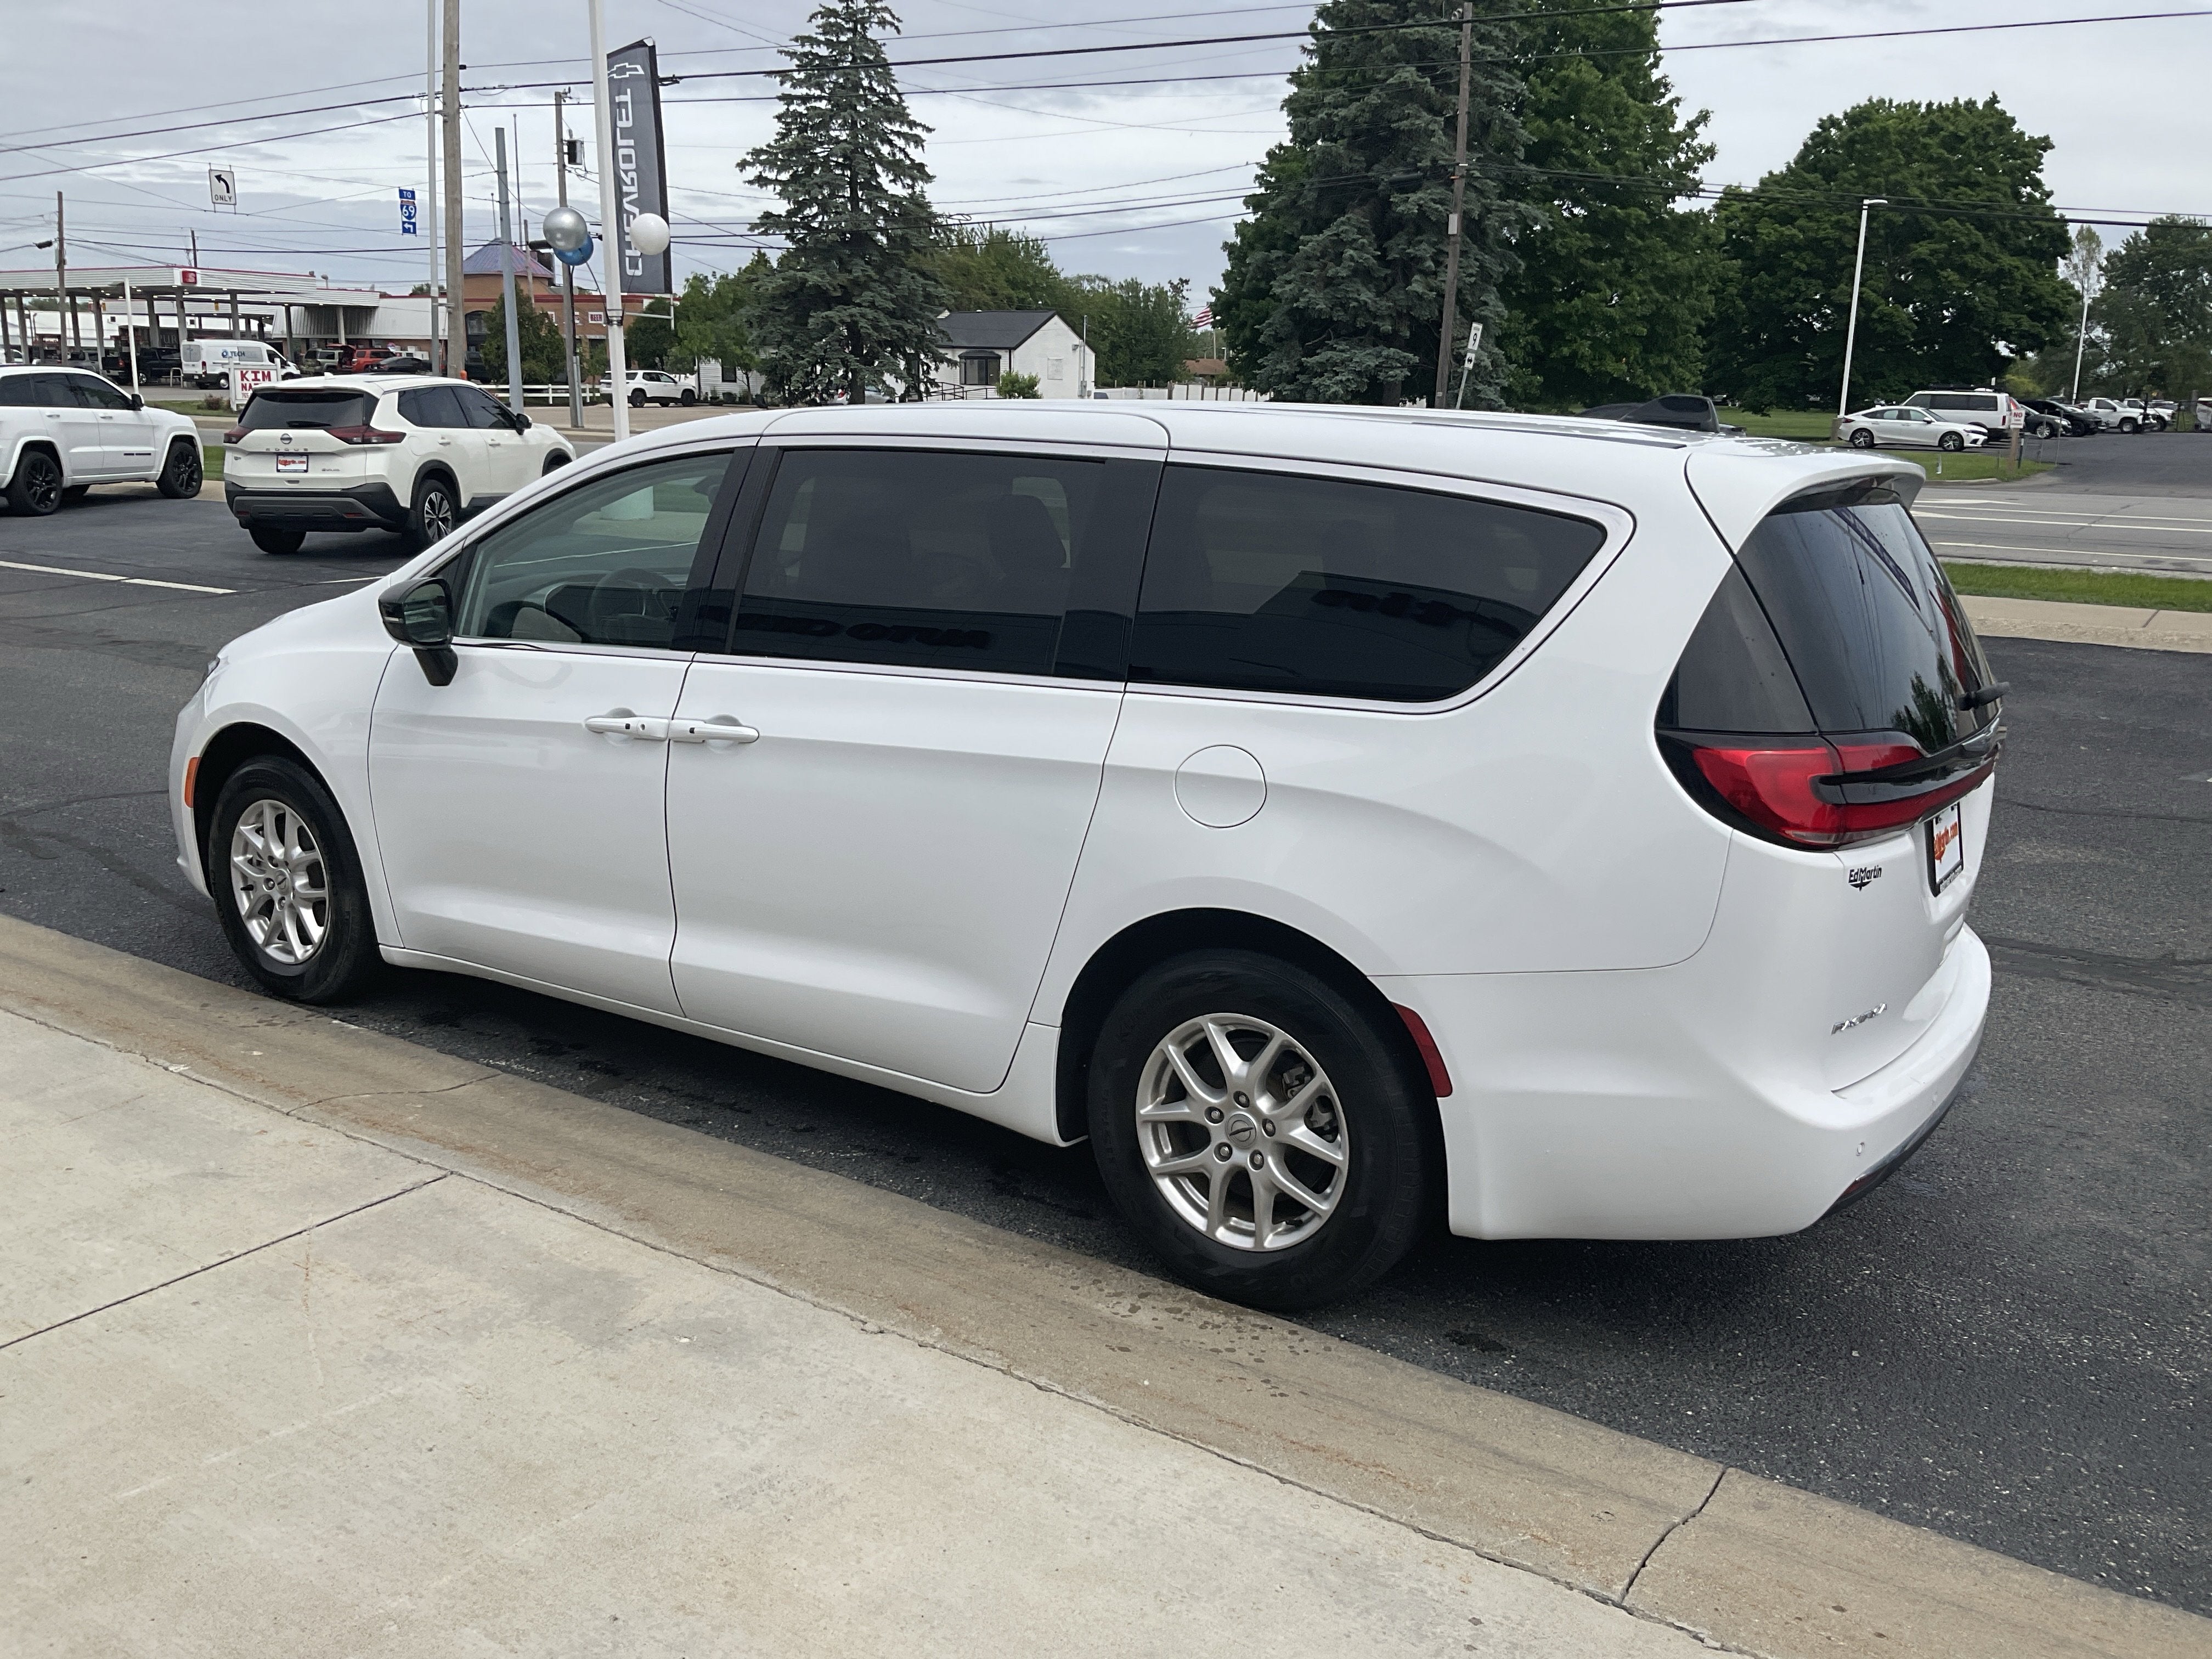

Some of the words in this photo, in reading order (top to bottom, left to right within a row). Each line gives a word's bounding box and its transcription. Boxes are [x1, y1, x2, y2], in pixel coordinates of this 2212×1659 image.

[215, 194, 233, 202] ONLY
[402, 205, 415, 217] 69
[240, 370, 272, 382] KIM
